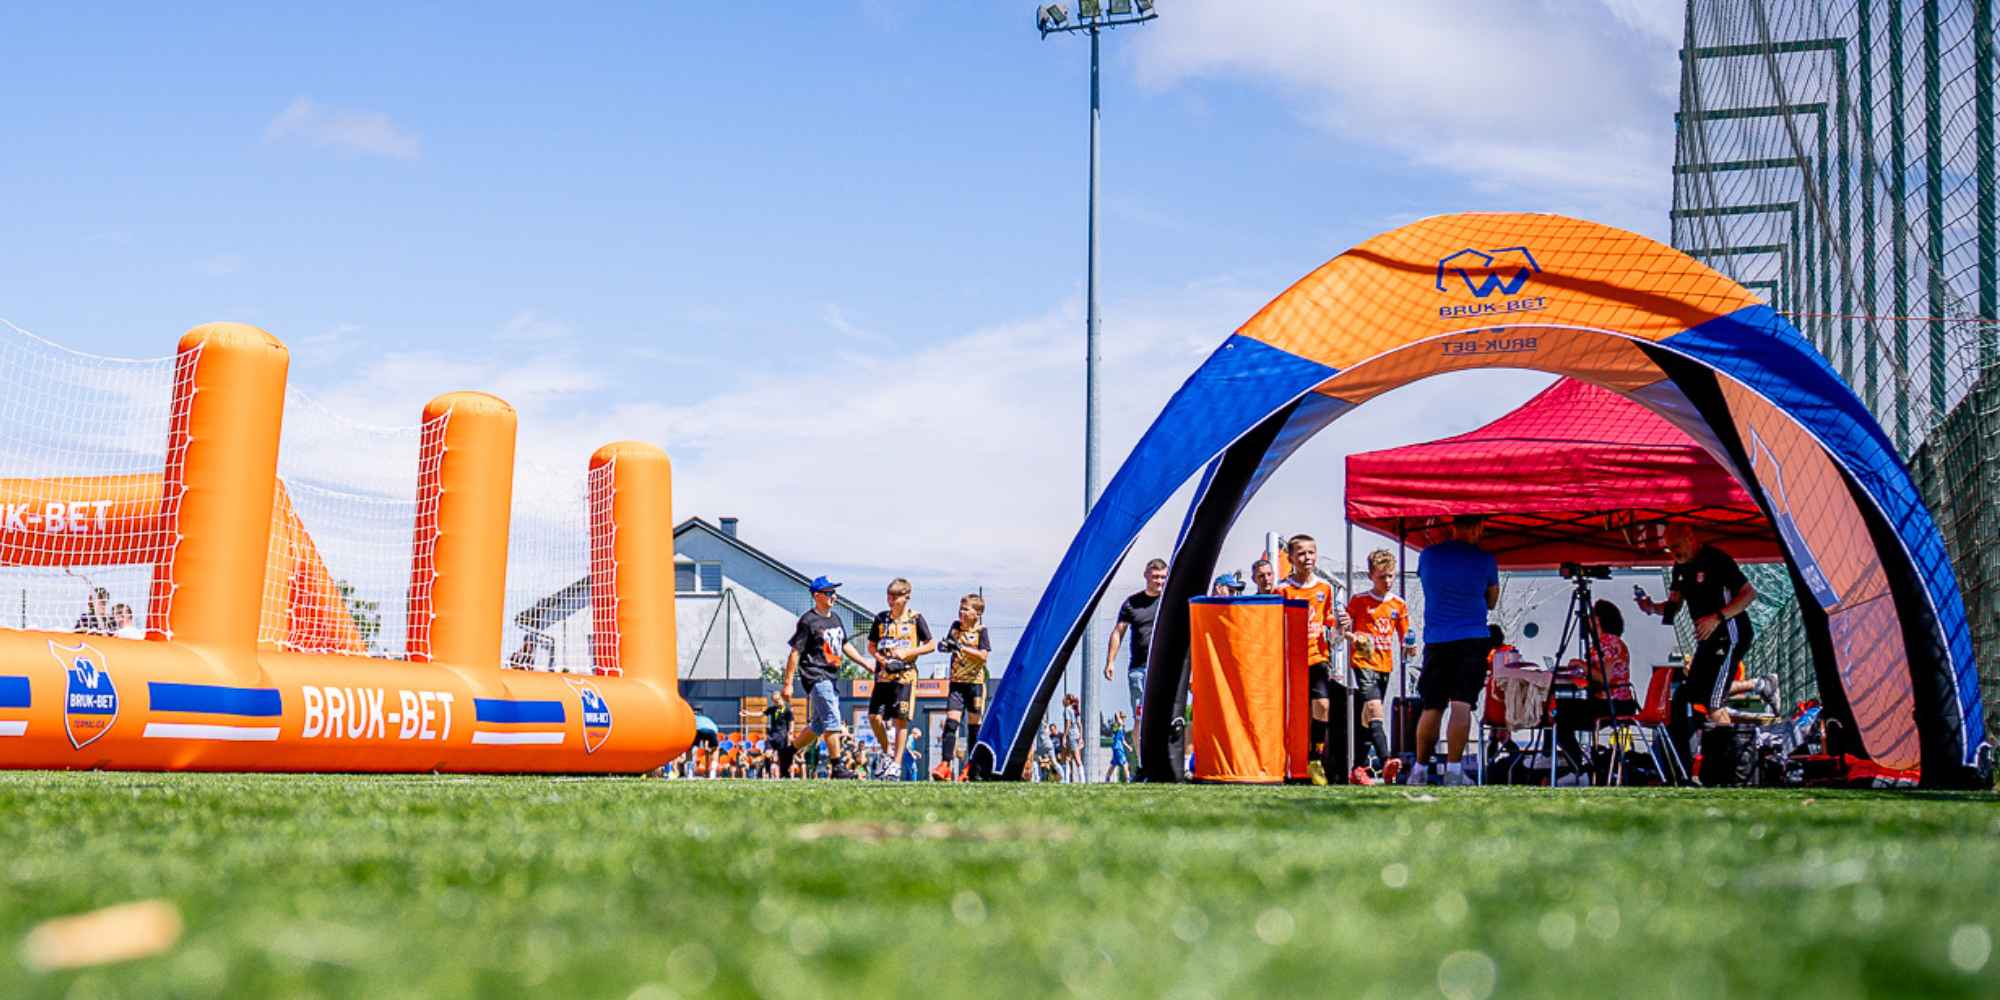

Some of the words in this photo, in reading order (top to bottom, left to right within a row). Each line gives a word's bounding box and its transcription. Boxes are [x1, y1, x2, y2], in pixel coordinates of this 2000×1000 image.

[1439, 296, 1547, 317] BRUK-BET
[0, 500, 112, 532] K-BET
[70, 694, 114, 708] BRUK-BET
[302, 686, 454, 740] BRUK-BET
